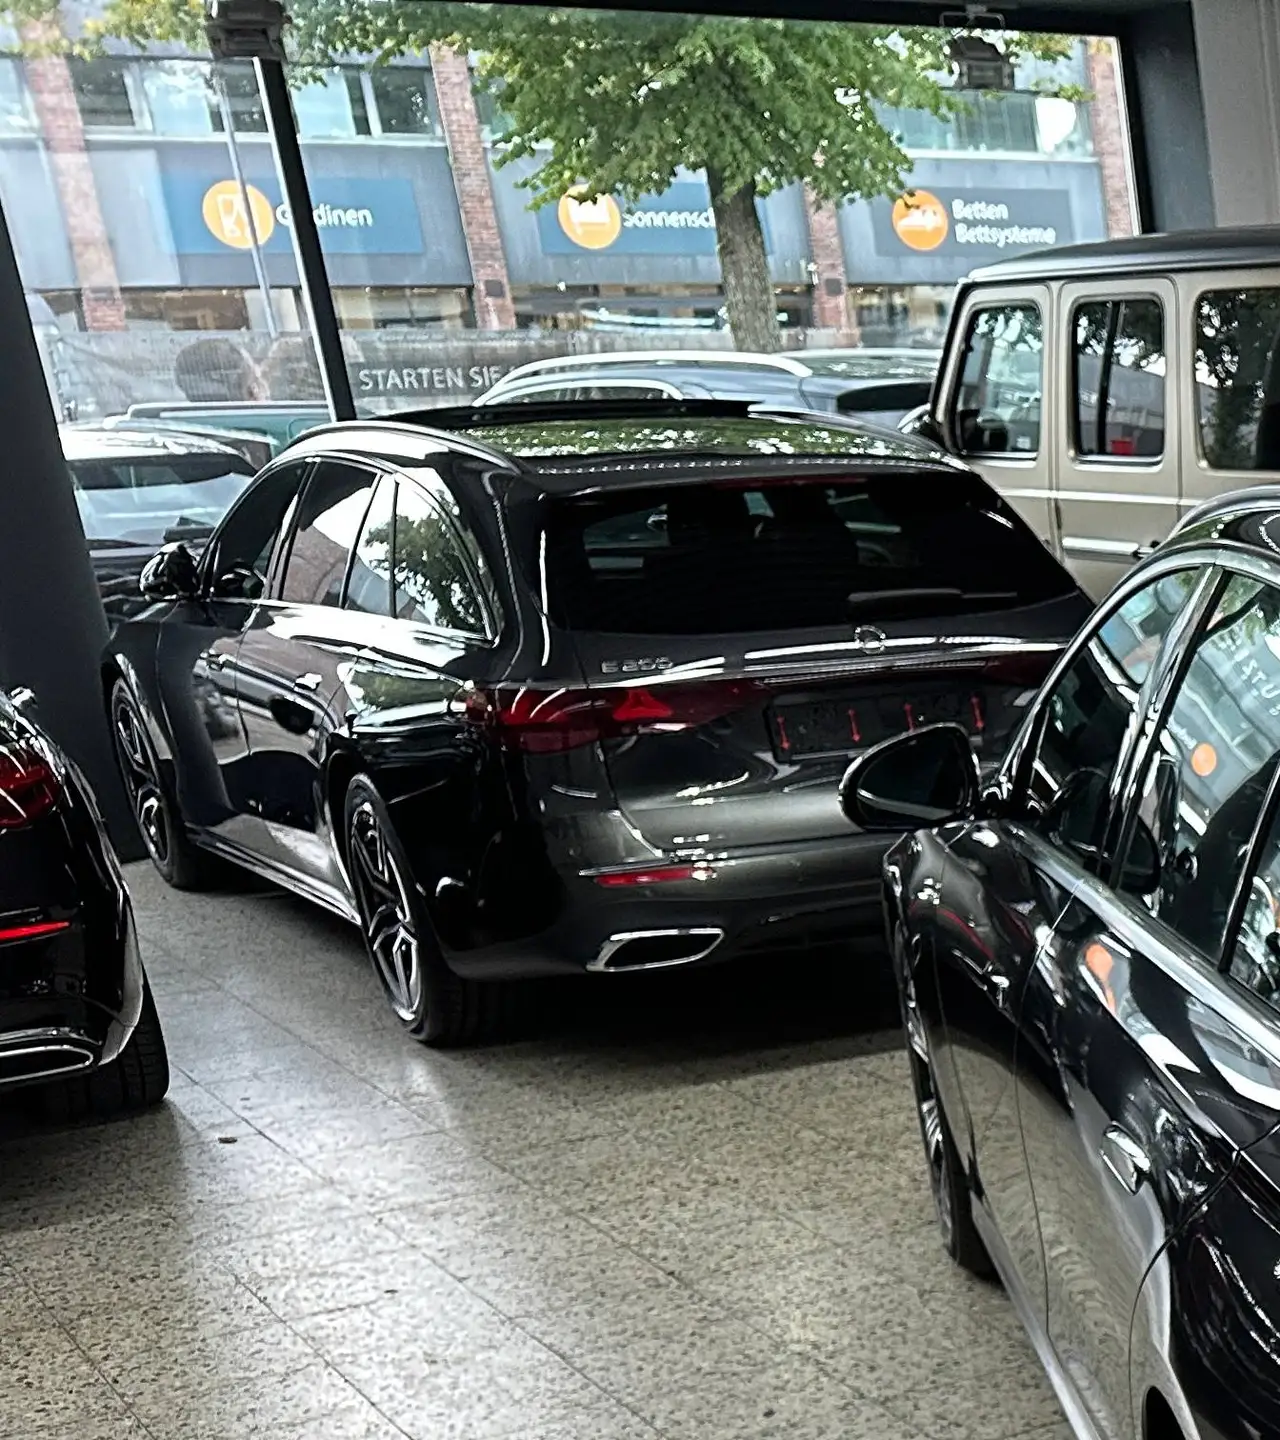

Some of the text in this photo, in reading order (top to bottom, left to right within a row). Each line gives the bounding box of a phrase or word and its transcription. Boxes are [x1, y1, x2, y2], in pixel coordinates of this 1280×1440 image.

[275, 203, 373, 227] Gdinen
[951, 199, 1009, 220] Betten
[954, 222, 1056, 248] Bettsysteme
[358, 367, 465, 391] STARTEN
